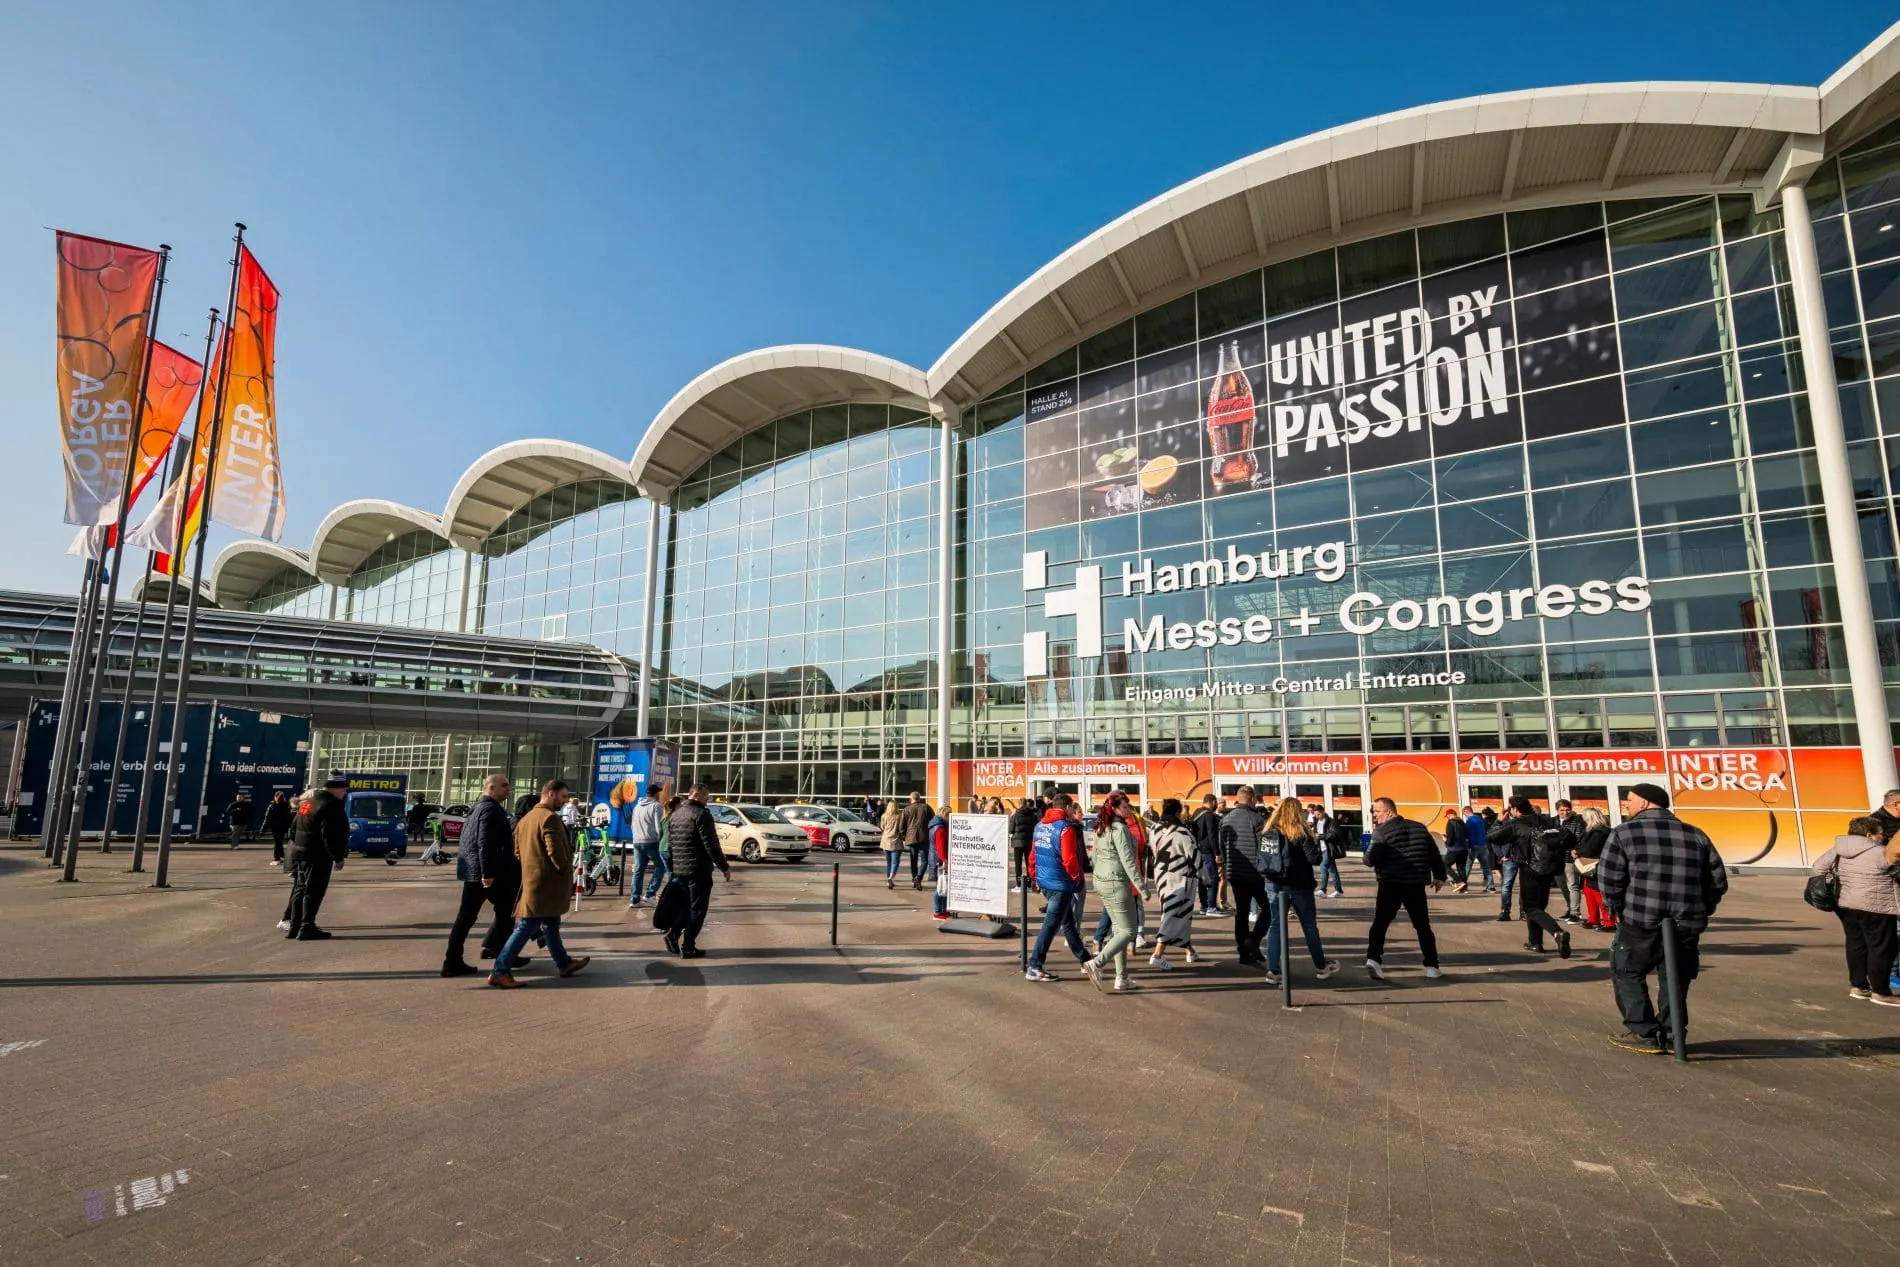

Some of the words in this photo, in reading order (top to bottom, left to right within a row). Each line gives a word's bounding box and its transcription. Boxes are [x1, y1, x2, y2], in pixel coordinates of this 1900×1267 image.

[1271, 307, 1432, 386] UNITED
[1448, 285, 1499, 335] BY
[1031, 393, 1057, 405] HALLE
[1059, 390, 1068, 398] A1
[1275, 327, 1508, 458] PASSION
[1032, 401, 1058, 413] STAND
[1058, 397, 1072, 407] 214
[1122, 541, 1346, 597] Hamburg
[1123, 614, 1273, 654] Messe
[1289, 607, 1321, 636] +
[1340, 576, 1652, 636] Congress
[1125, 686, 1196, 704] Eingang
[1202, 681, 1255, 698] Mitte
[1272, 671, 1351, 694] Central
[1362, 669, 1466, 690] Entrance
[220, 761, 235, 772] The
[236, 761, 256, 773] ideal
[256, 764, 296, 774] connection
[976, 762, 1013, 774] INTER
[1034, 762, 1058, 773] Alle
[1061, 763, 1141, 774] zusammen.
[1232, 757, 1349, 772] Willkommen!
[1468, 755, 1511, 771] Alle
[1517, 757, 1657, 772] zusammen.
[1672, 753, 1759, 771] INTER
[349, 780, 400, 789] METRO
[976, 775, 1024, 787] NORGA
[1674, 772, 1787, 791] NORGA
[952, 834, 984, 843] Busshuttle
[952, 842, 996, 851] INTERNORGA
